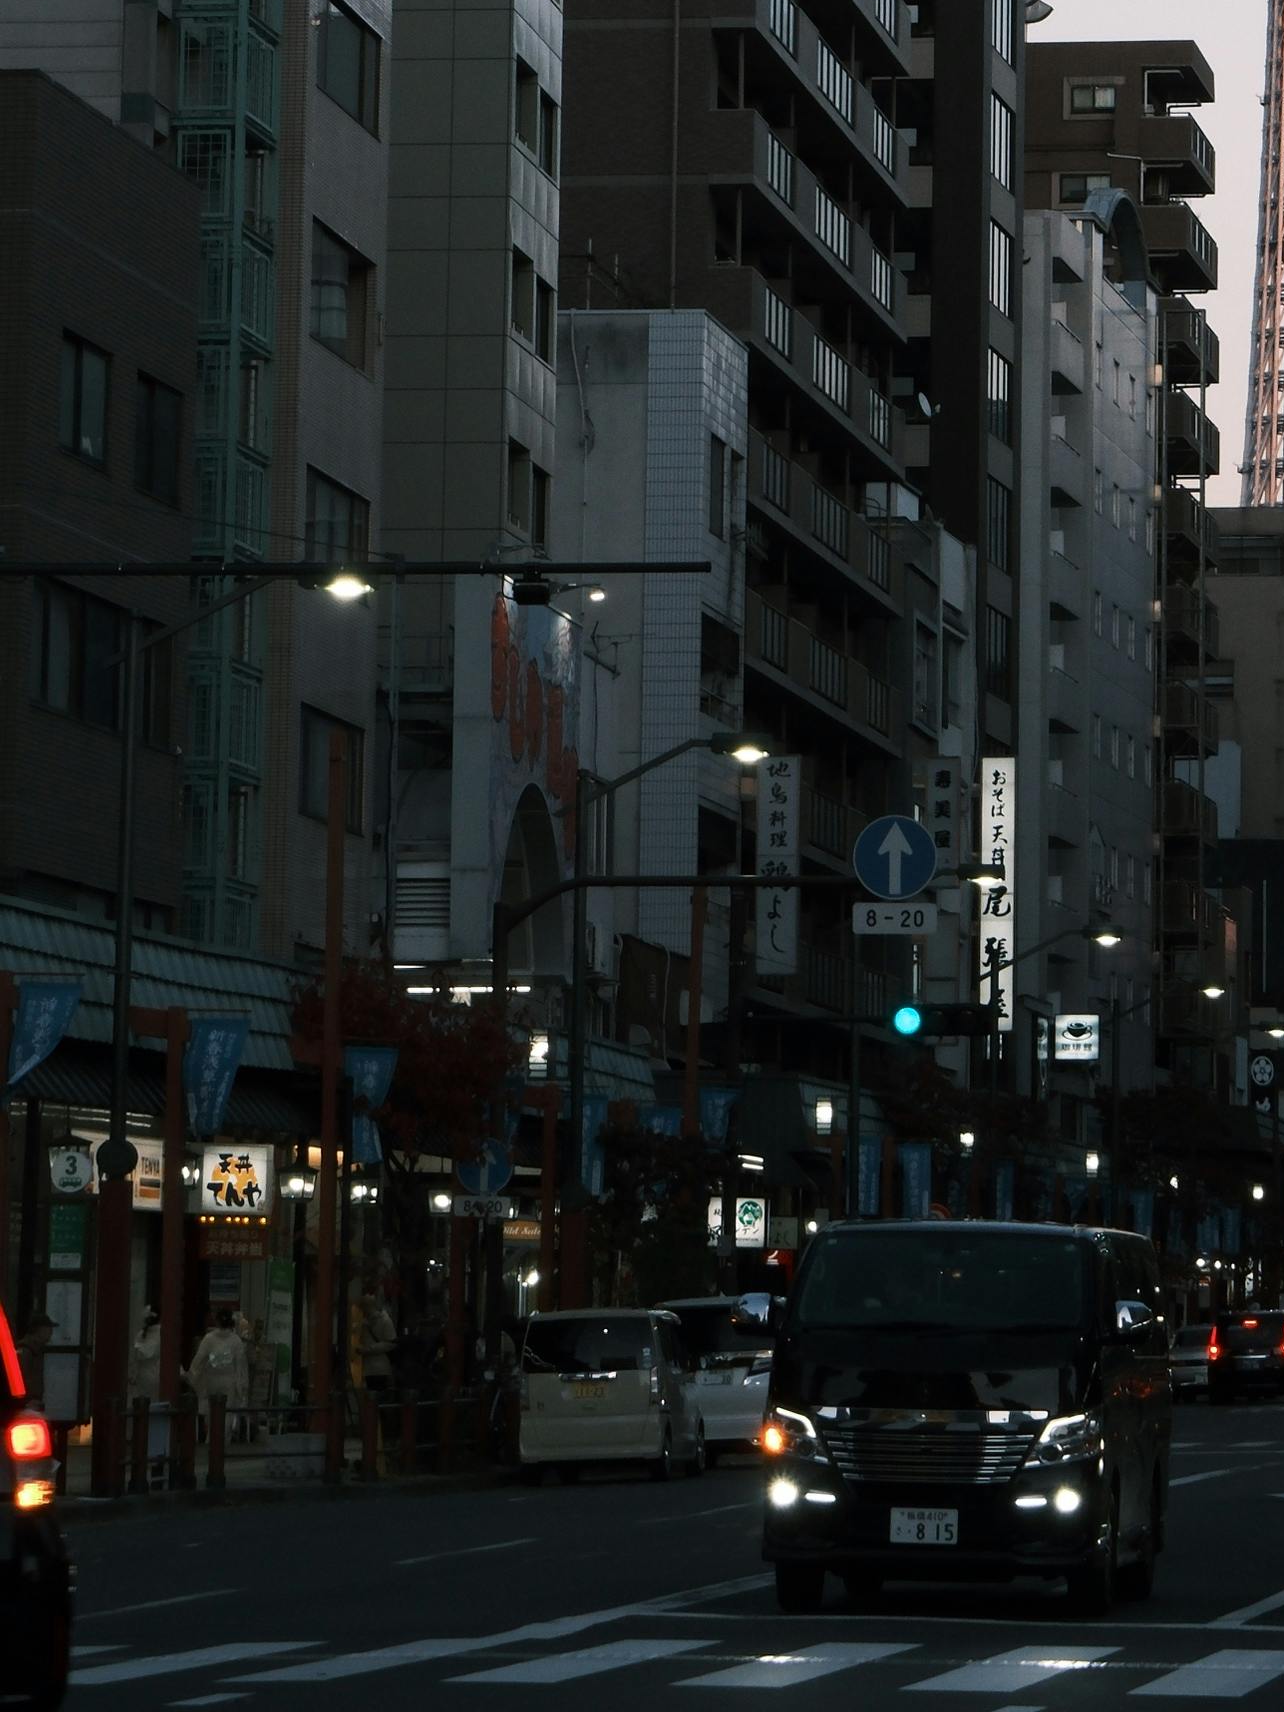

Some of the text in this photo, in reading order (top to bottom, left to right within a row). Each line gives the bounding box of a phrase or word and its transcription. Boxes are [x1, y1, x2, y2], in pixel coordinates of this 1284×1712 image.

[991, 769, 1007, 818] おそば
[866, 909, 924, 928] 8-20
[65, 1155, 77, 1175] 3
[207, 1181, 262, 1207] てんや
